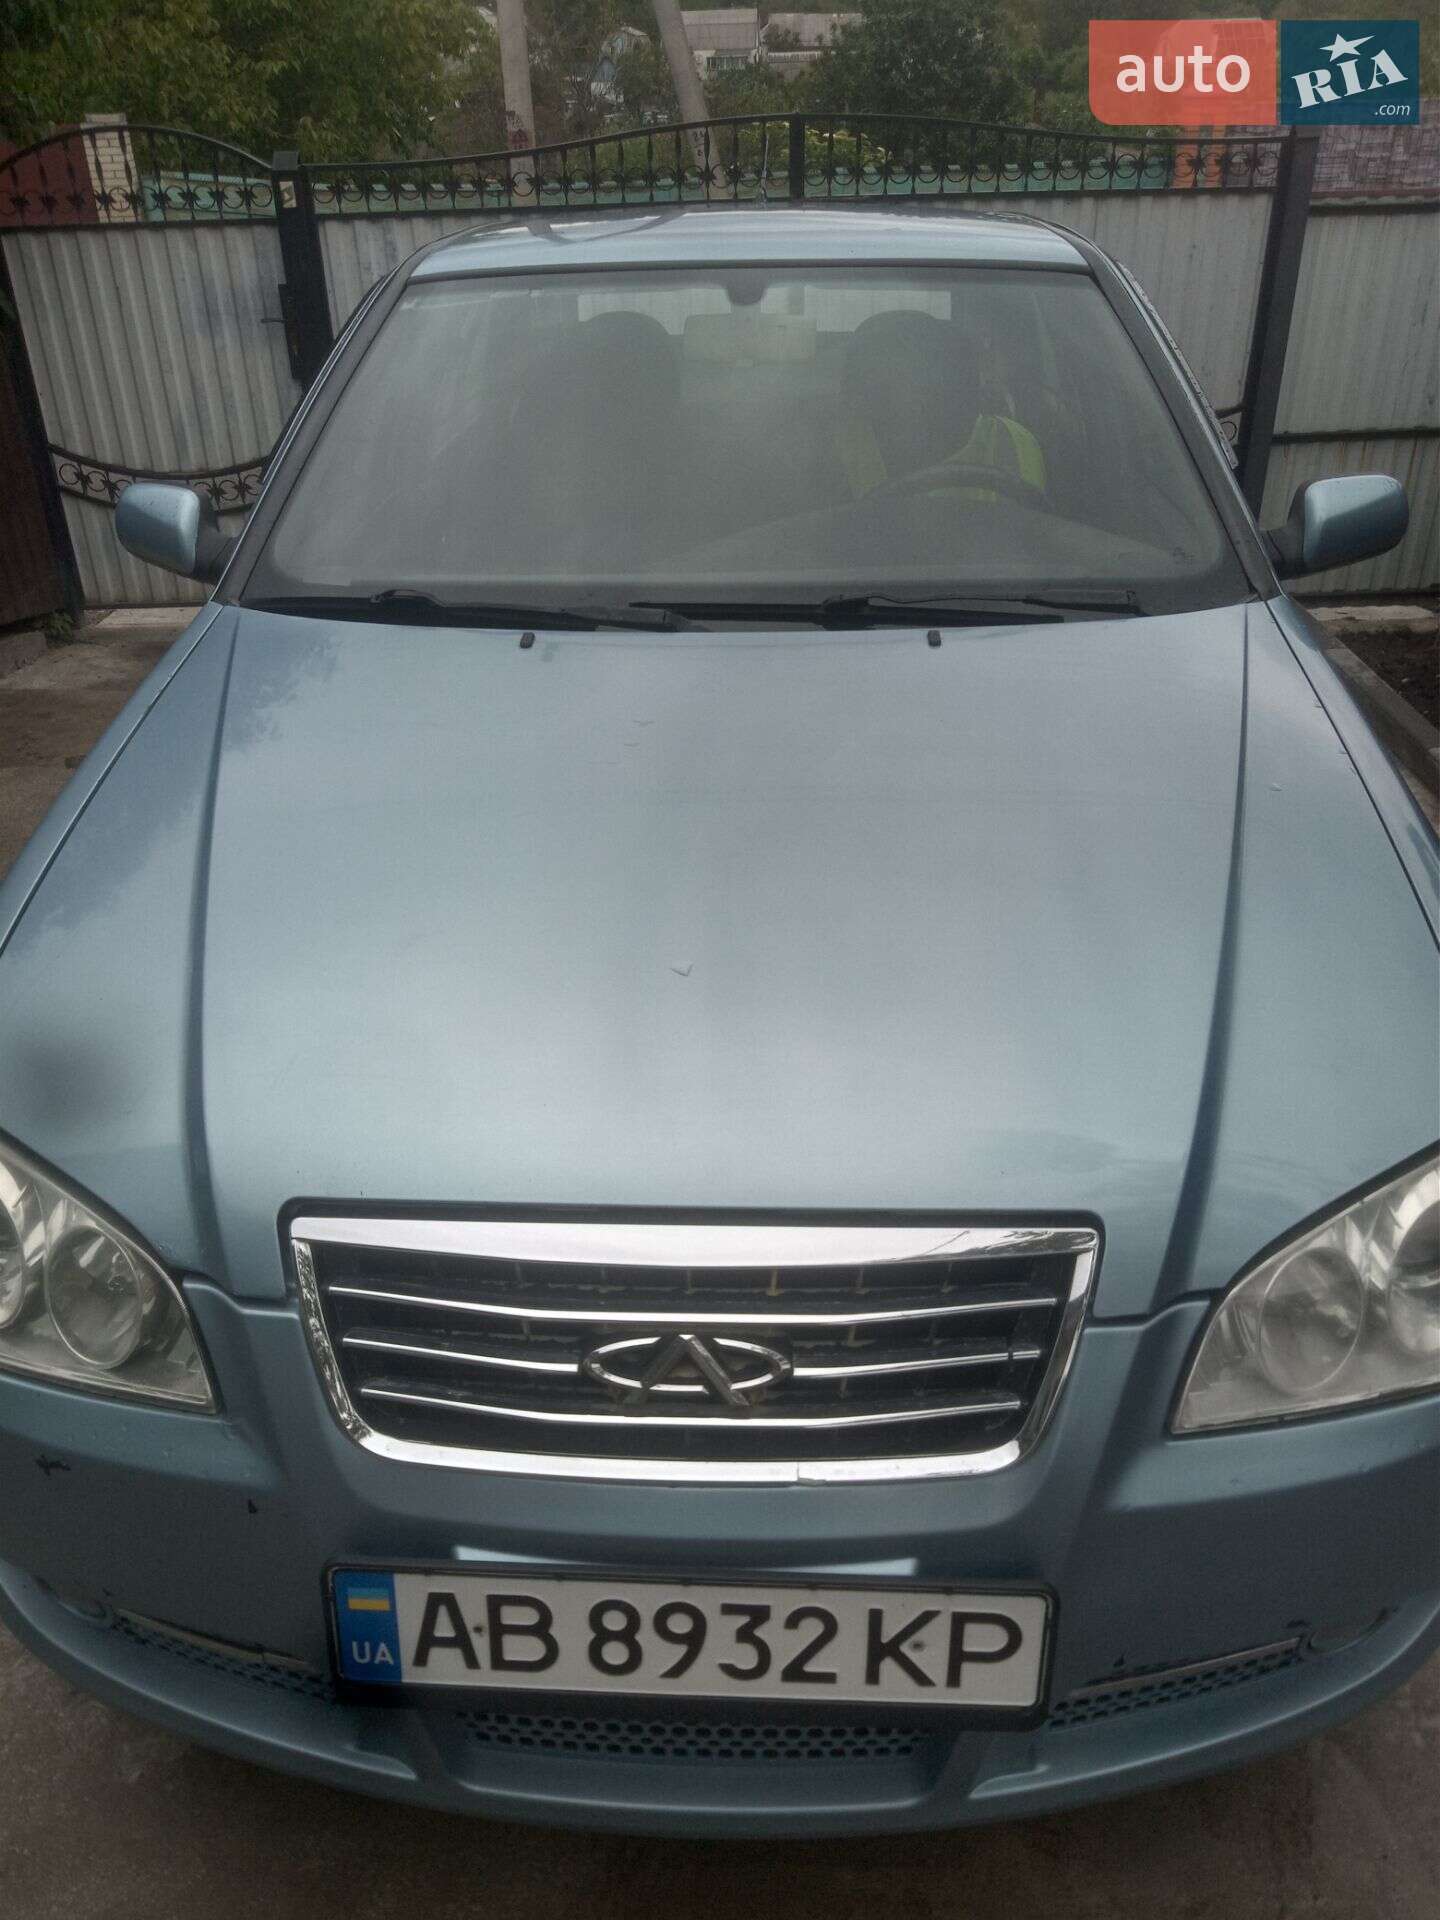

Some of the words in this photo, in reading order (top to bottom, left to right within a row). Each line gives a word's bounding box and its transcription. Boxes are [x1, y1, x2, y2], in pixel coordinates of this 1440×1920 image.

[351, 1640, 395, 1665] UA
[412, 1592, 560, 1673] AB
[587, 1599, 838, 1685] 8932
[865, 1608, 1023, 1689] KP
